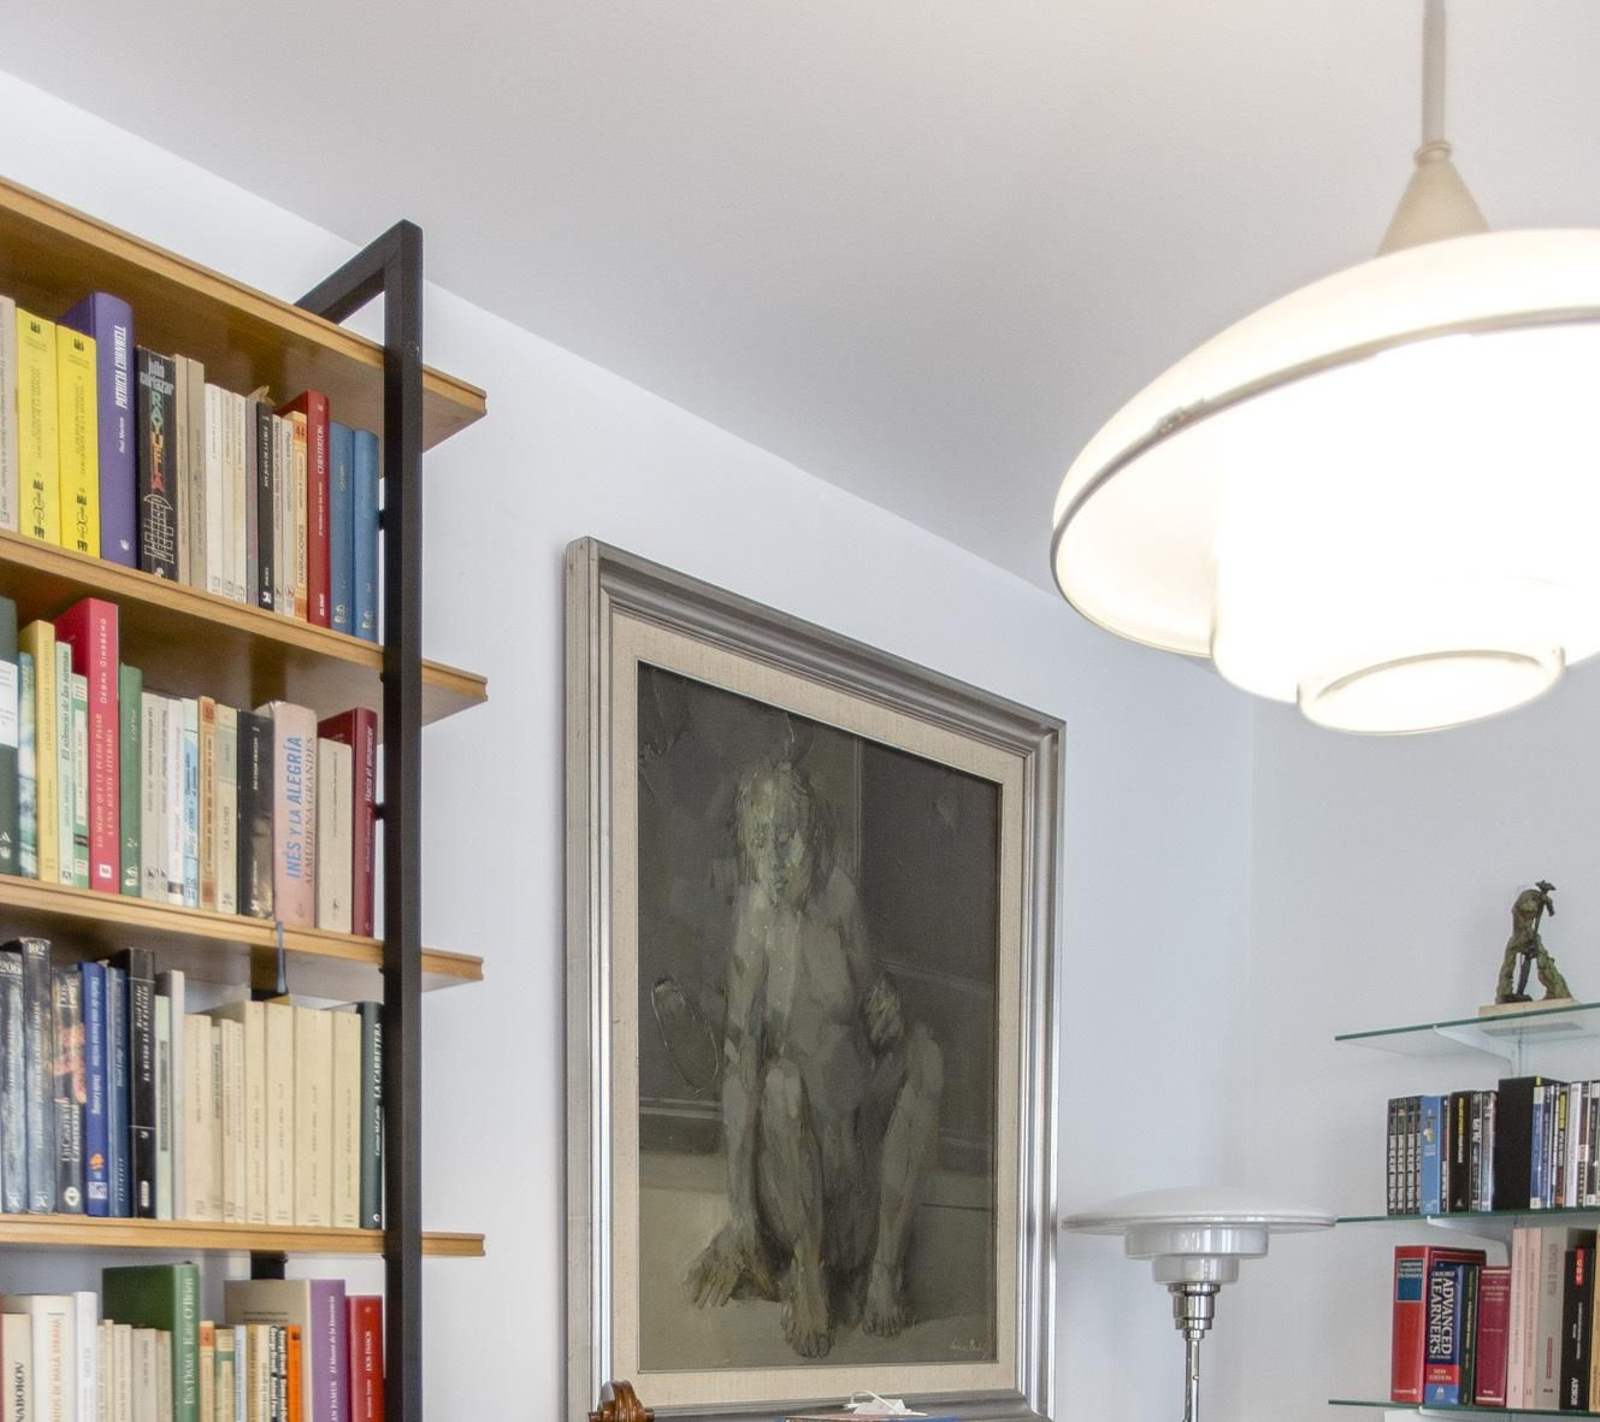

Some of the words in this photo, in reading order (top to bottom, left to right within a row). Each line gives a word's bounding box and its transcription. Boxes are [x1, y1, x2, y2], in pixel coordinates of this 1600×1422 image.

[114, 370, 127, 409] PATRICIA
[61, 686, 69, 698] las
[282, 736, 302, 804] ALEGRÍA
[306, 736, 314, 804] GRANDES
[288, 810, 302, 824] LA
[288, 828, 302, 836] Y
[281, 841, 302, 878] INÉS
[306, 807, 314, 886] ALMUDENA
[374, 1085, 381, 1098] LA
[1429, 1277, 1442, 1354] LEARNER'S
[1441, 1276, 1454, 1354] ADVANCED
[182, 1352, 194, 1384] DAMA
[330, 1381, 338, 1408] PAMUK
